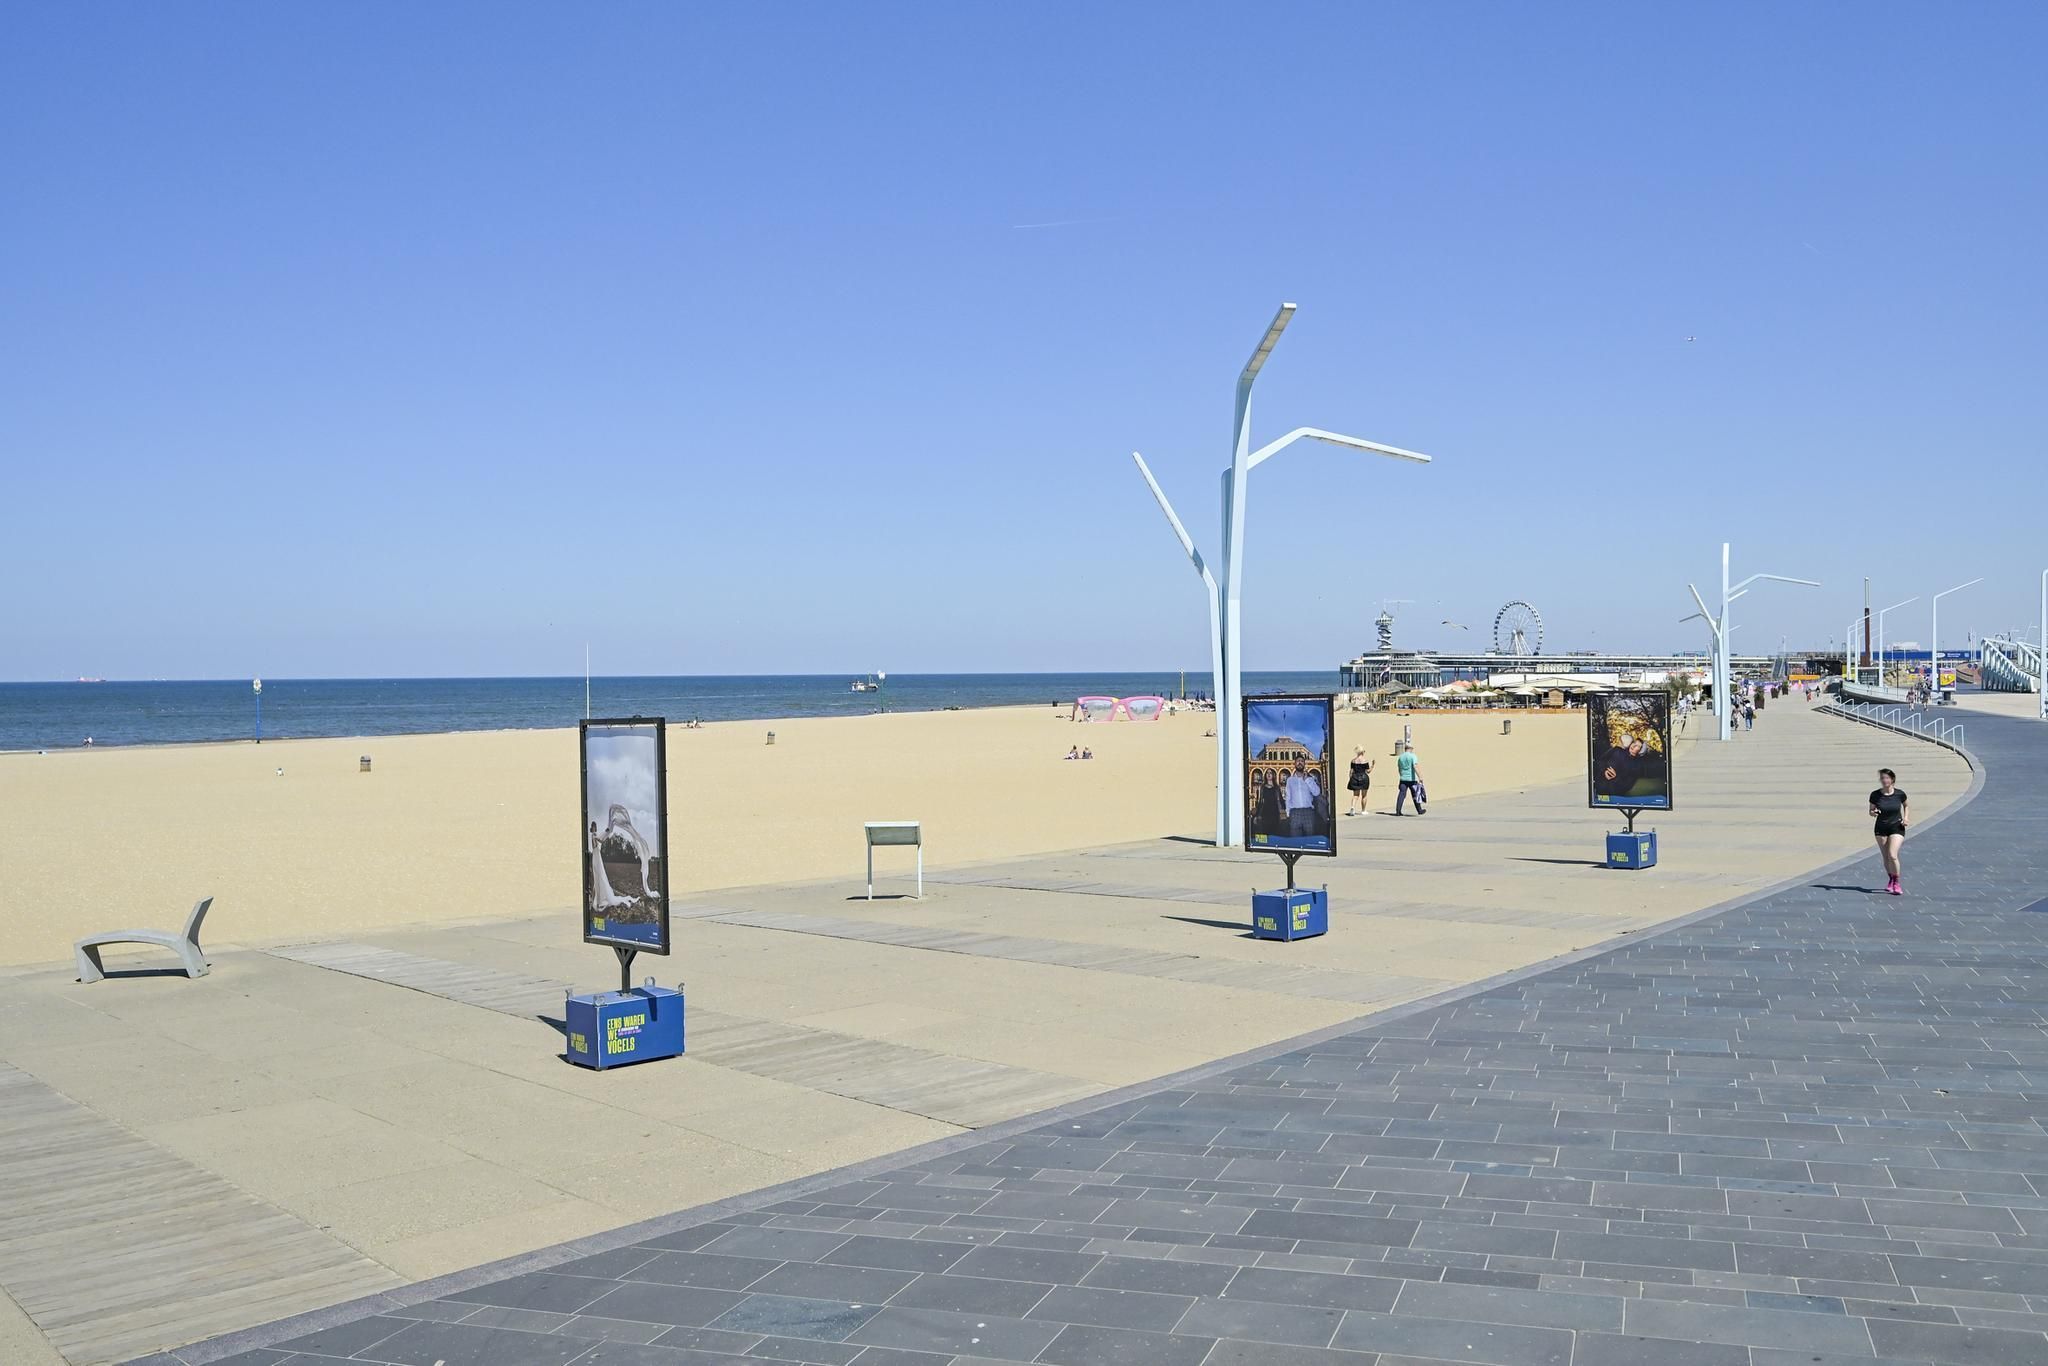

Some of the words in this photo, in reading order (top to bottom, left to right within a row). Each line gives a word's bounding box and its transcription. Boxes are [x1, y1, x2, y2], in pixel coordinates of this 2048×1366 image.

[607, 1017, 622, 1029] EENS
[623, 1013, 645, 1027] WAREN
[608, 1029, 618, 1040] WE
[607, 1037, 635, 1054] VOGELS
